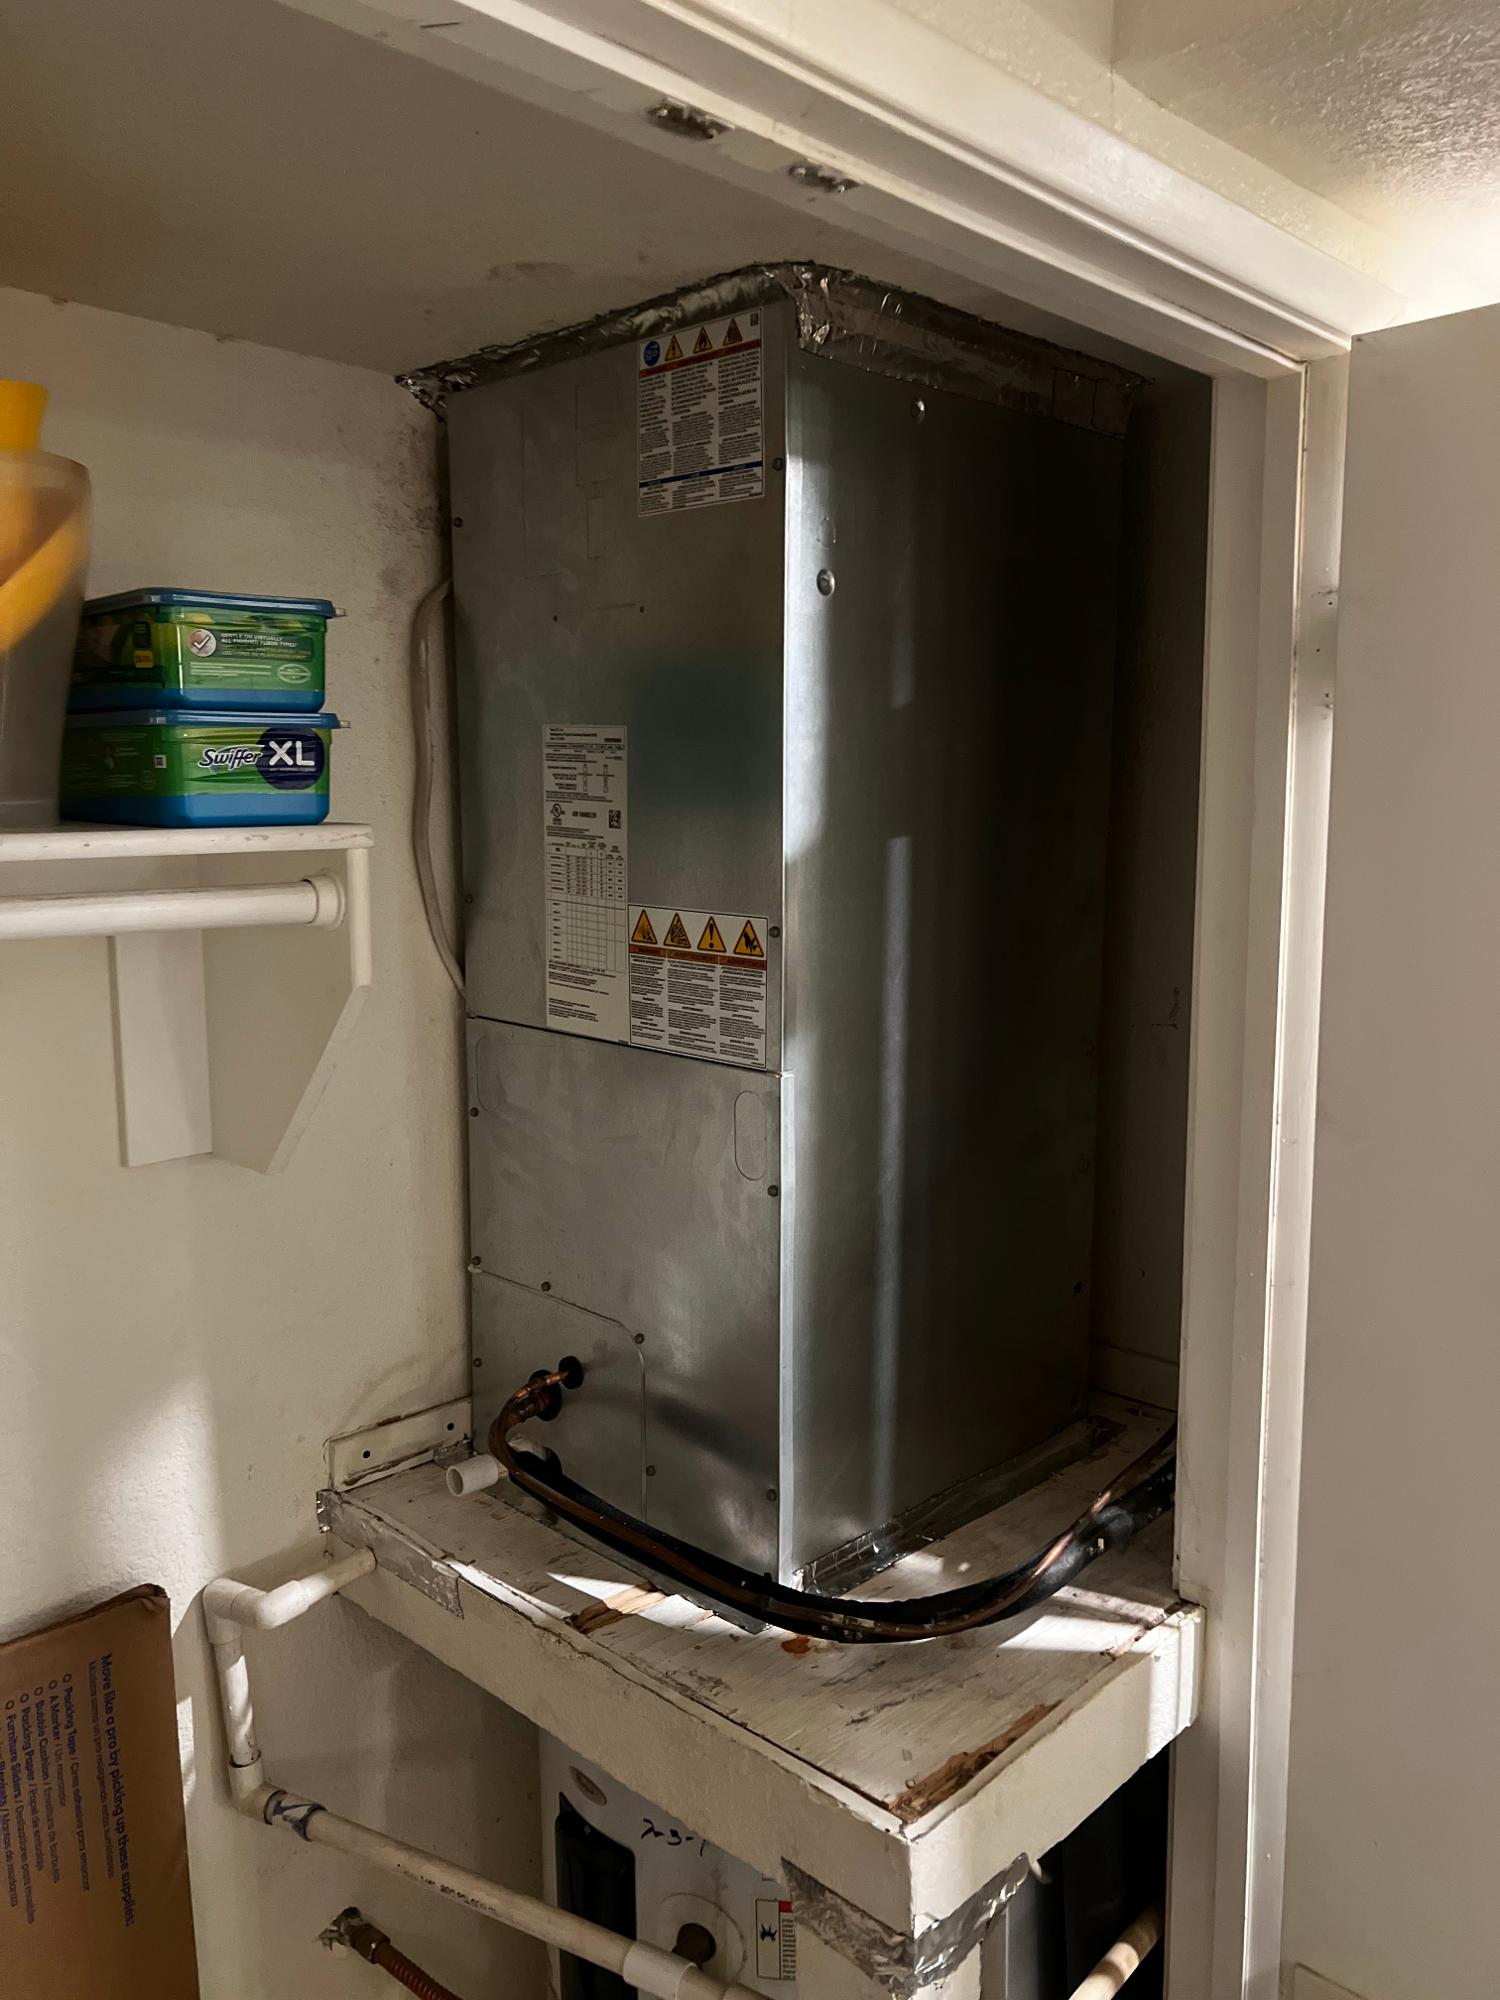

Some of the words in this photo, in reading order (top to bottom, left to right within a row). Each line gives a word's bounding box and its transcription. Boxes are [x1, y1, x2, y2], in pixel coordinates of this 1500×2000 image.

[197, 746, 264, 771] Swiffer
[268, 740, 316, 767] XL
[101, 1654, 113, 1690] Move
[50, 1695, 59, 1704] A
[64, 1686, 76, 1729] Packing
[104, 1692, 116, 1714] like
[22, 1706, 32, 1750] Packing
[35, 1700, 48, 1737] Bubble
[50, 1704, 61, 1741] Marker
[106, 1716, 113, 1726] a
[7, 1714, 19, 1762] Furniture
[68, 1729, 77, 1755] Tape
[105, 1727, 117, 1749] pro
[25, 1750, 36, 1781] Paper
[39, 1738, 50, 1780] Cushion
[109, 1751, 121, 1766] by
[11, 1762, 23, 1798] Sliders
[112, 1769, 126, 1816] picking
[115, 1818, 124, 1834] up
[119, 1835, 129, 1870] these
[121, 1872, 135, 1927] supplies:
